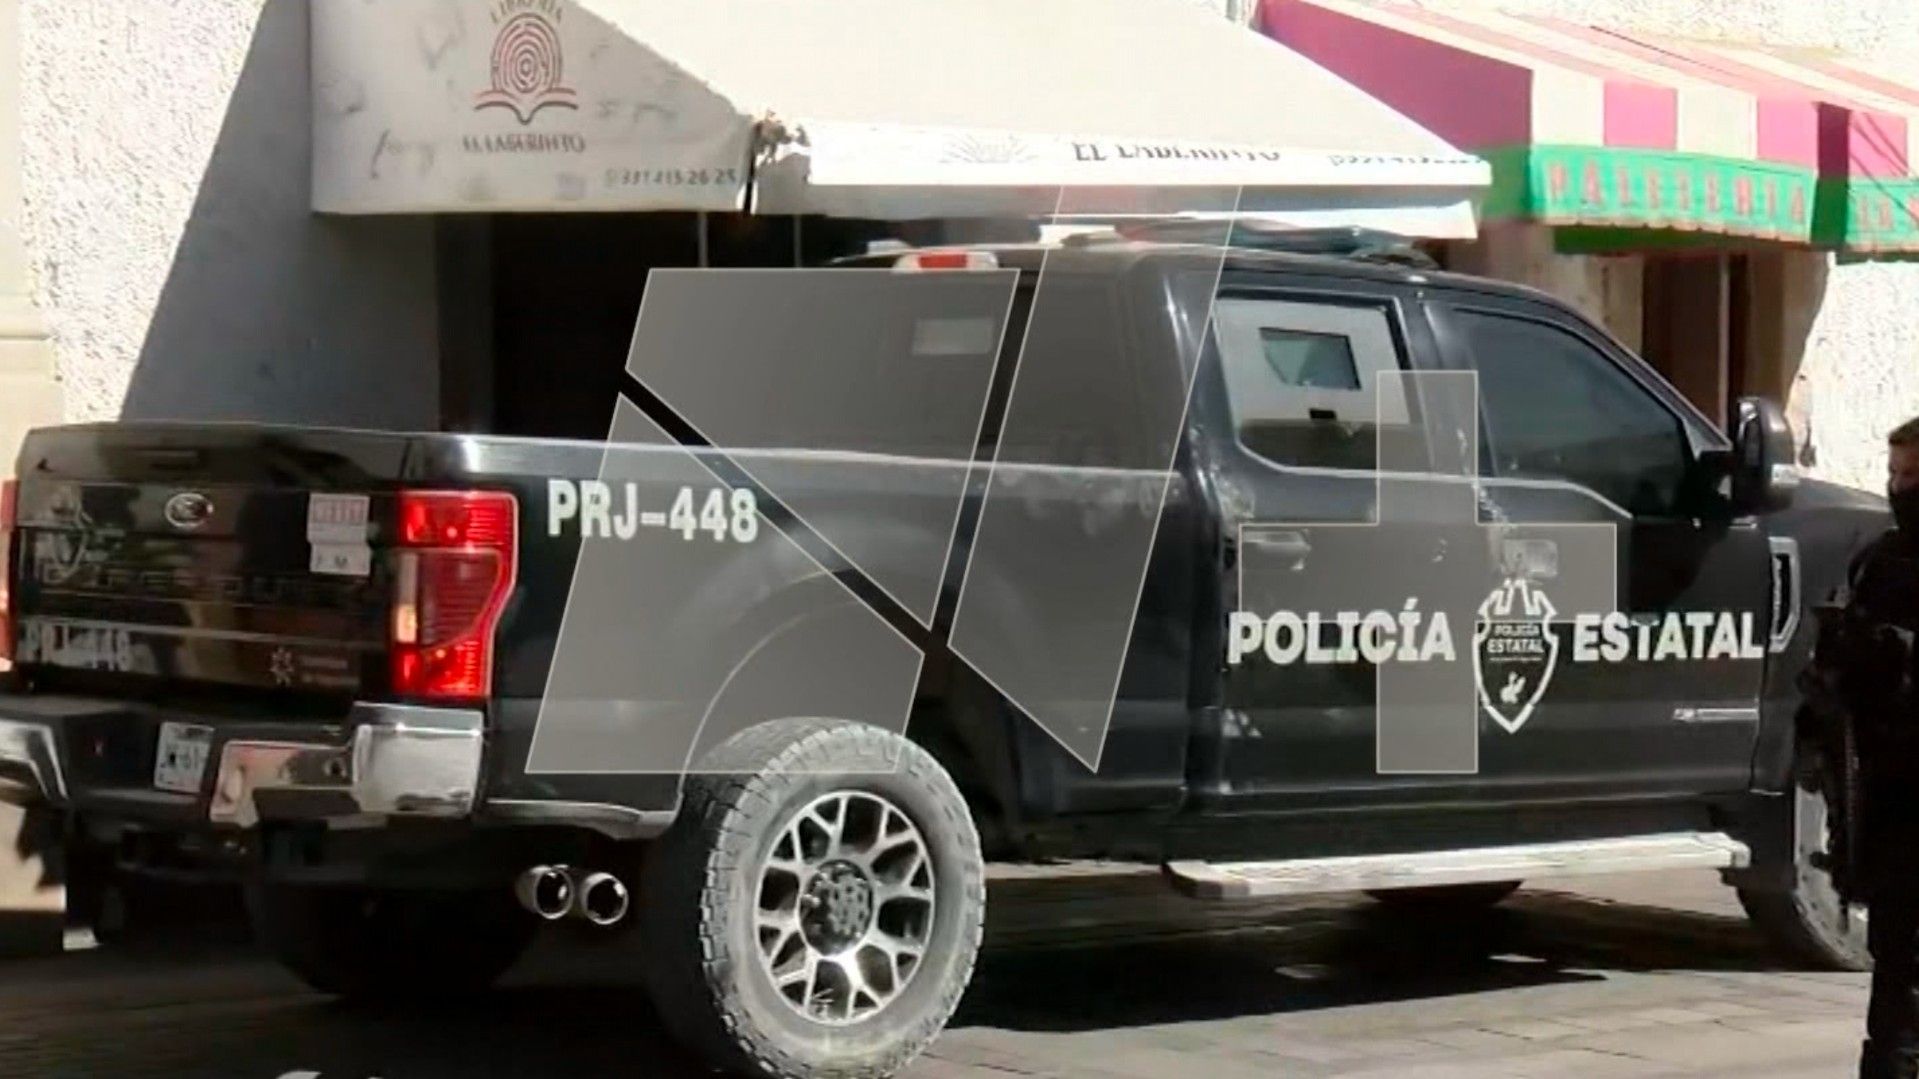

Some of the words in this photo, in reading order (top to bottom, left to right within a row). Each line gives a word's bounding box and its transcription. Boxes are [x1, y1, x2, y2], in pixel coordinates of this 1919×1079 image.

[1549, 161, 1806, 224] PALETERIA
[547, 478, 759, 543] PRJ-448
[1227, 598, 1456, 664] POLICÍA
[1573, 611, 1763, 662] ESTATAL
